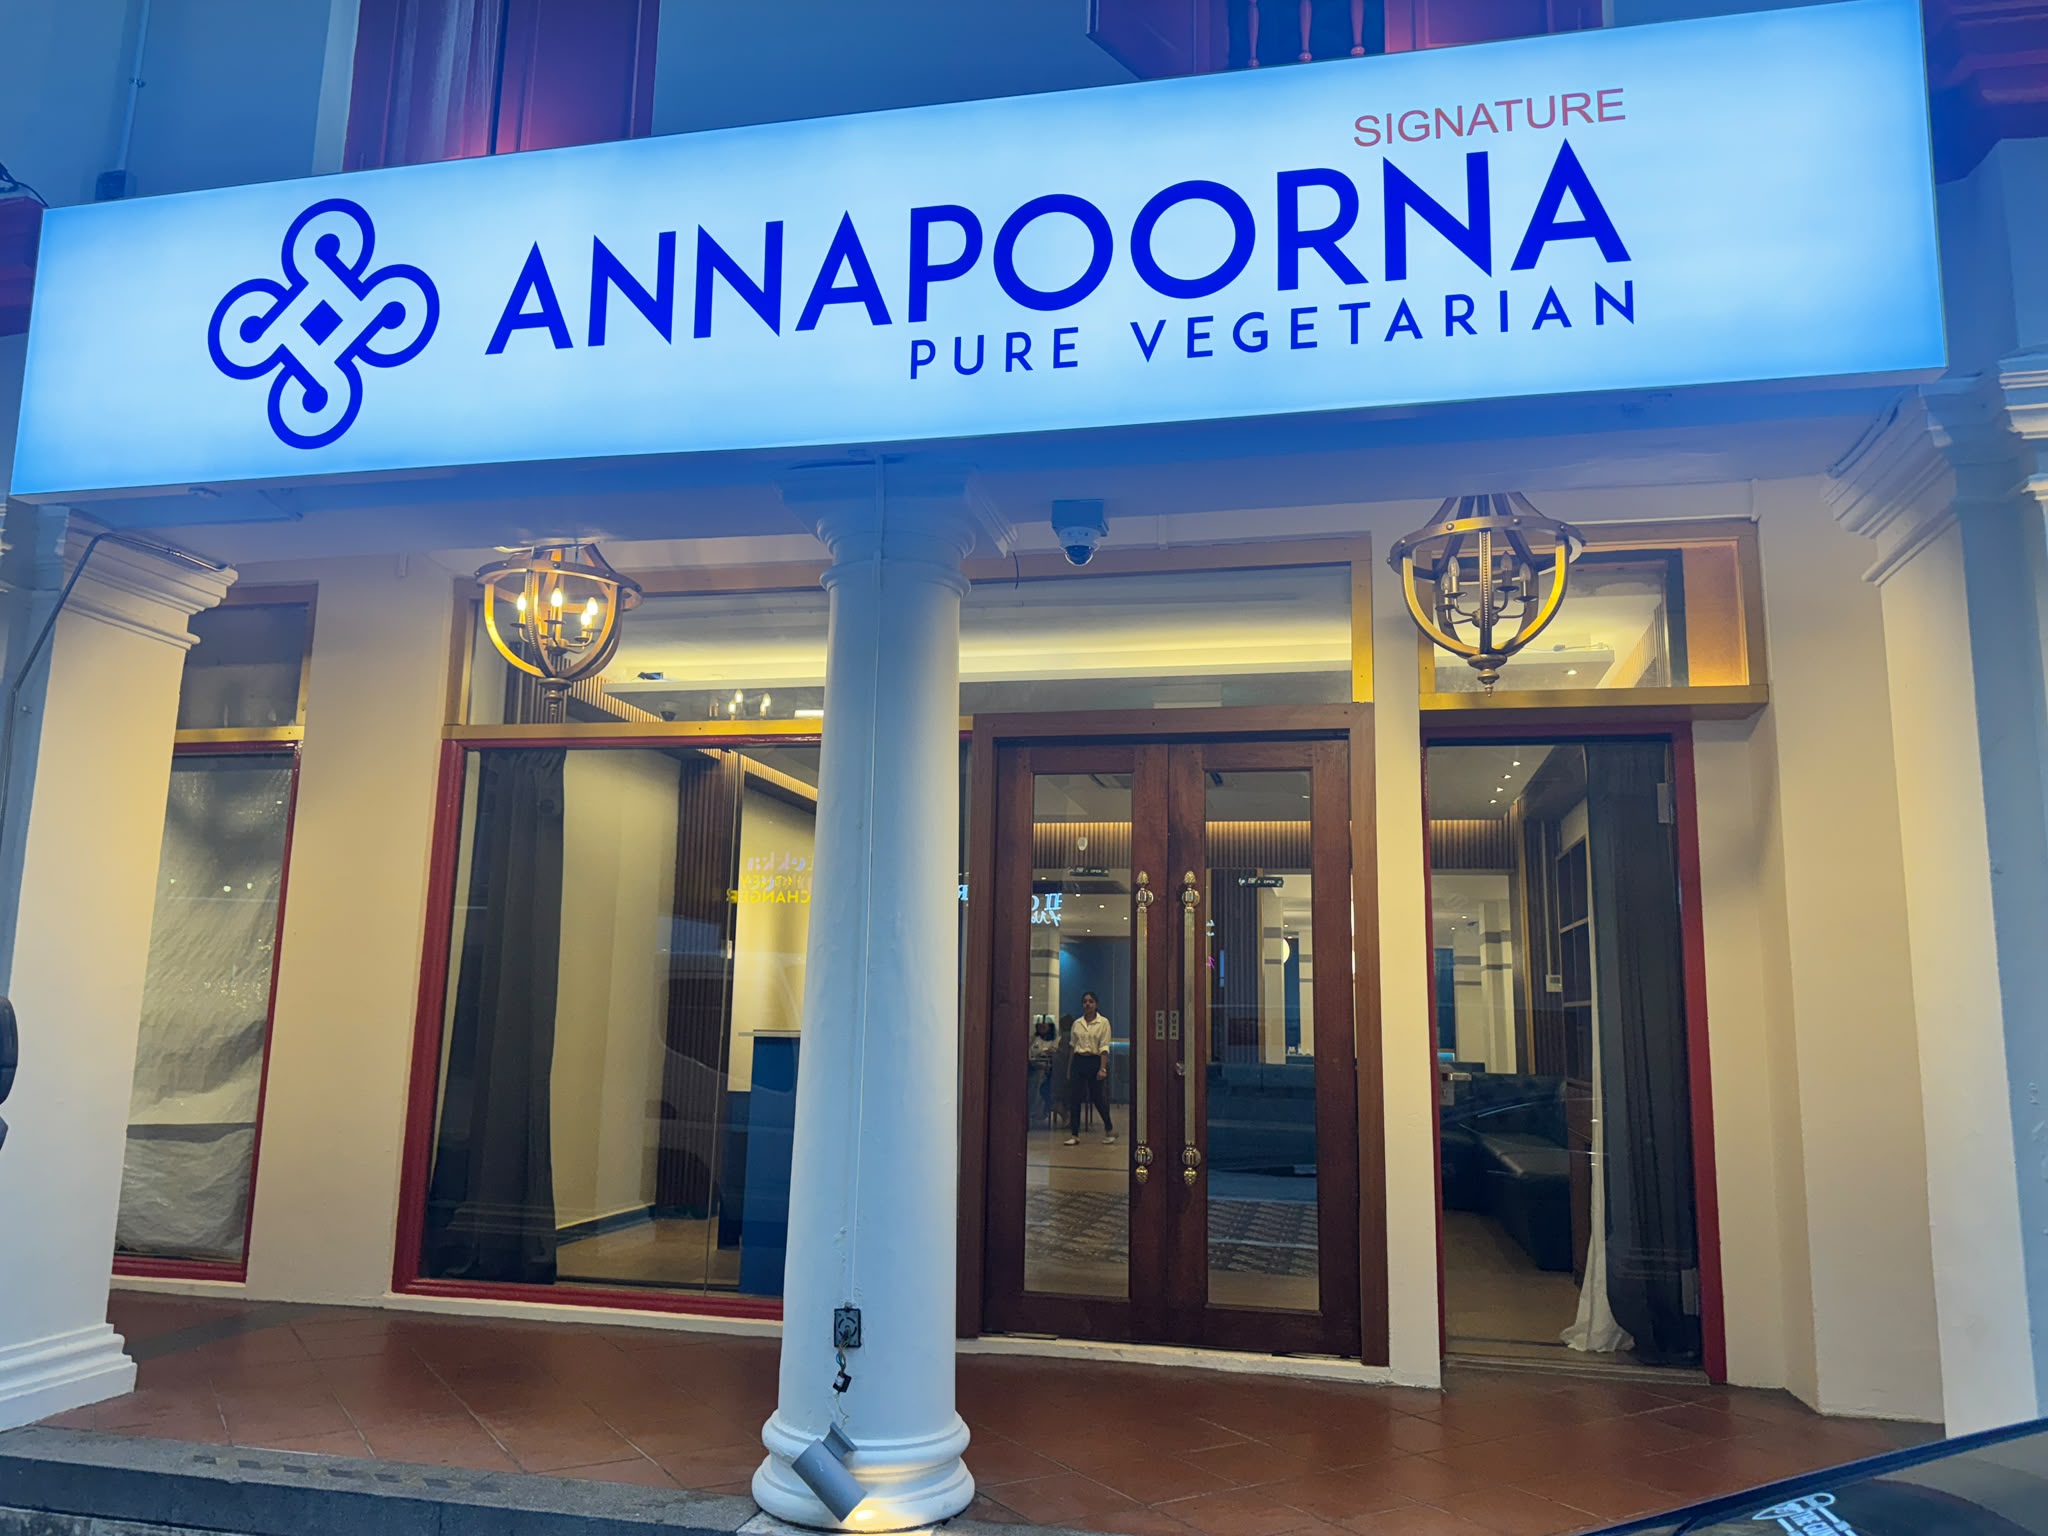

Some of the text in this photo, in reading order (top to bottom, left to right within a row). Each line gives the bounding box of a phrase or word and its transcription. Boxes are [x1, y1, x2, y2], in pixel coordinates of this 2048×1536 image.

[1355, 88, 1624, 146] SIGNATURE
[485, 138, 1632, 355] ANNAPOORNA
[910, 280, 1635, 380] PURE VEGETARIAN
